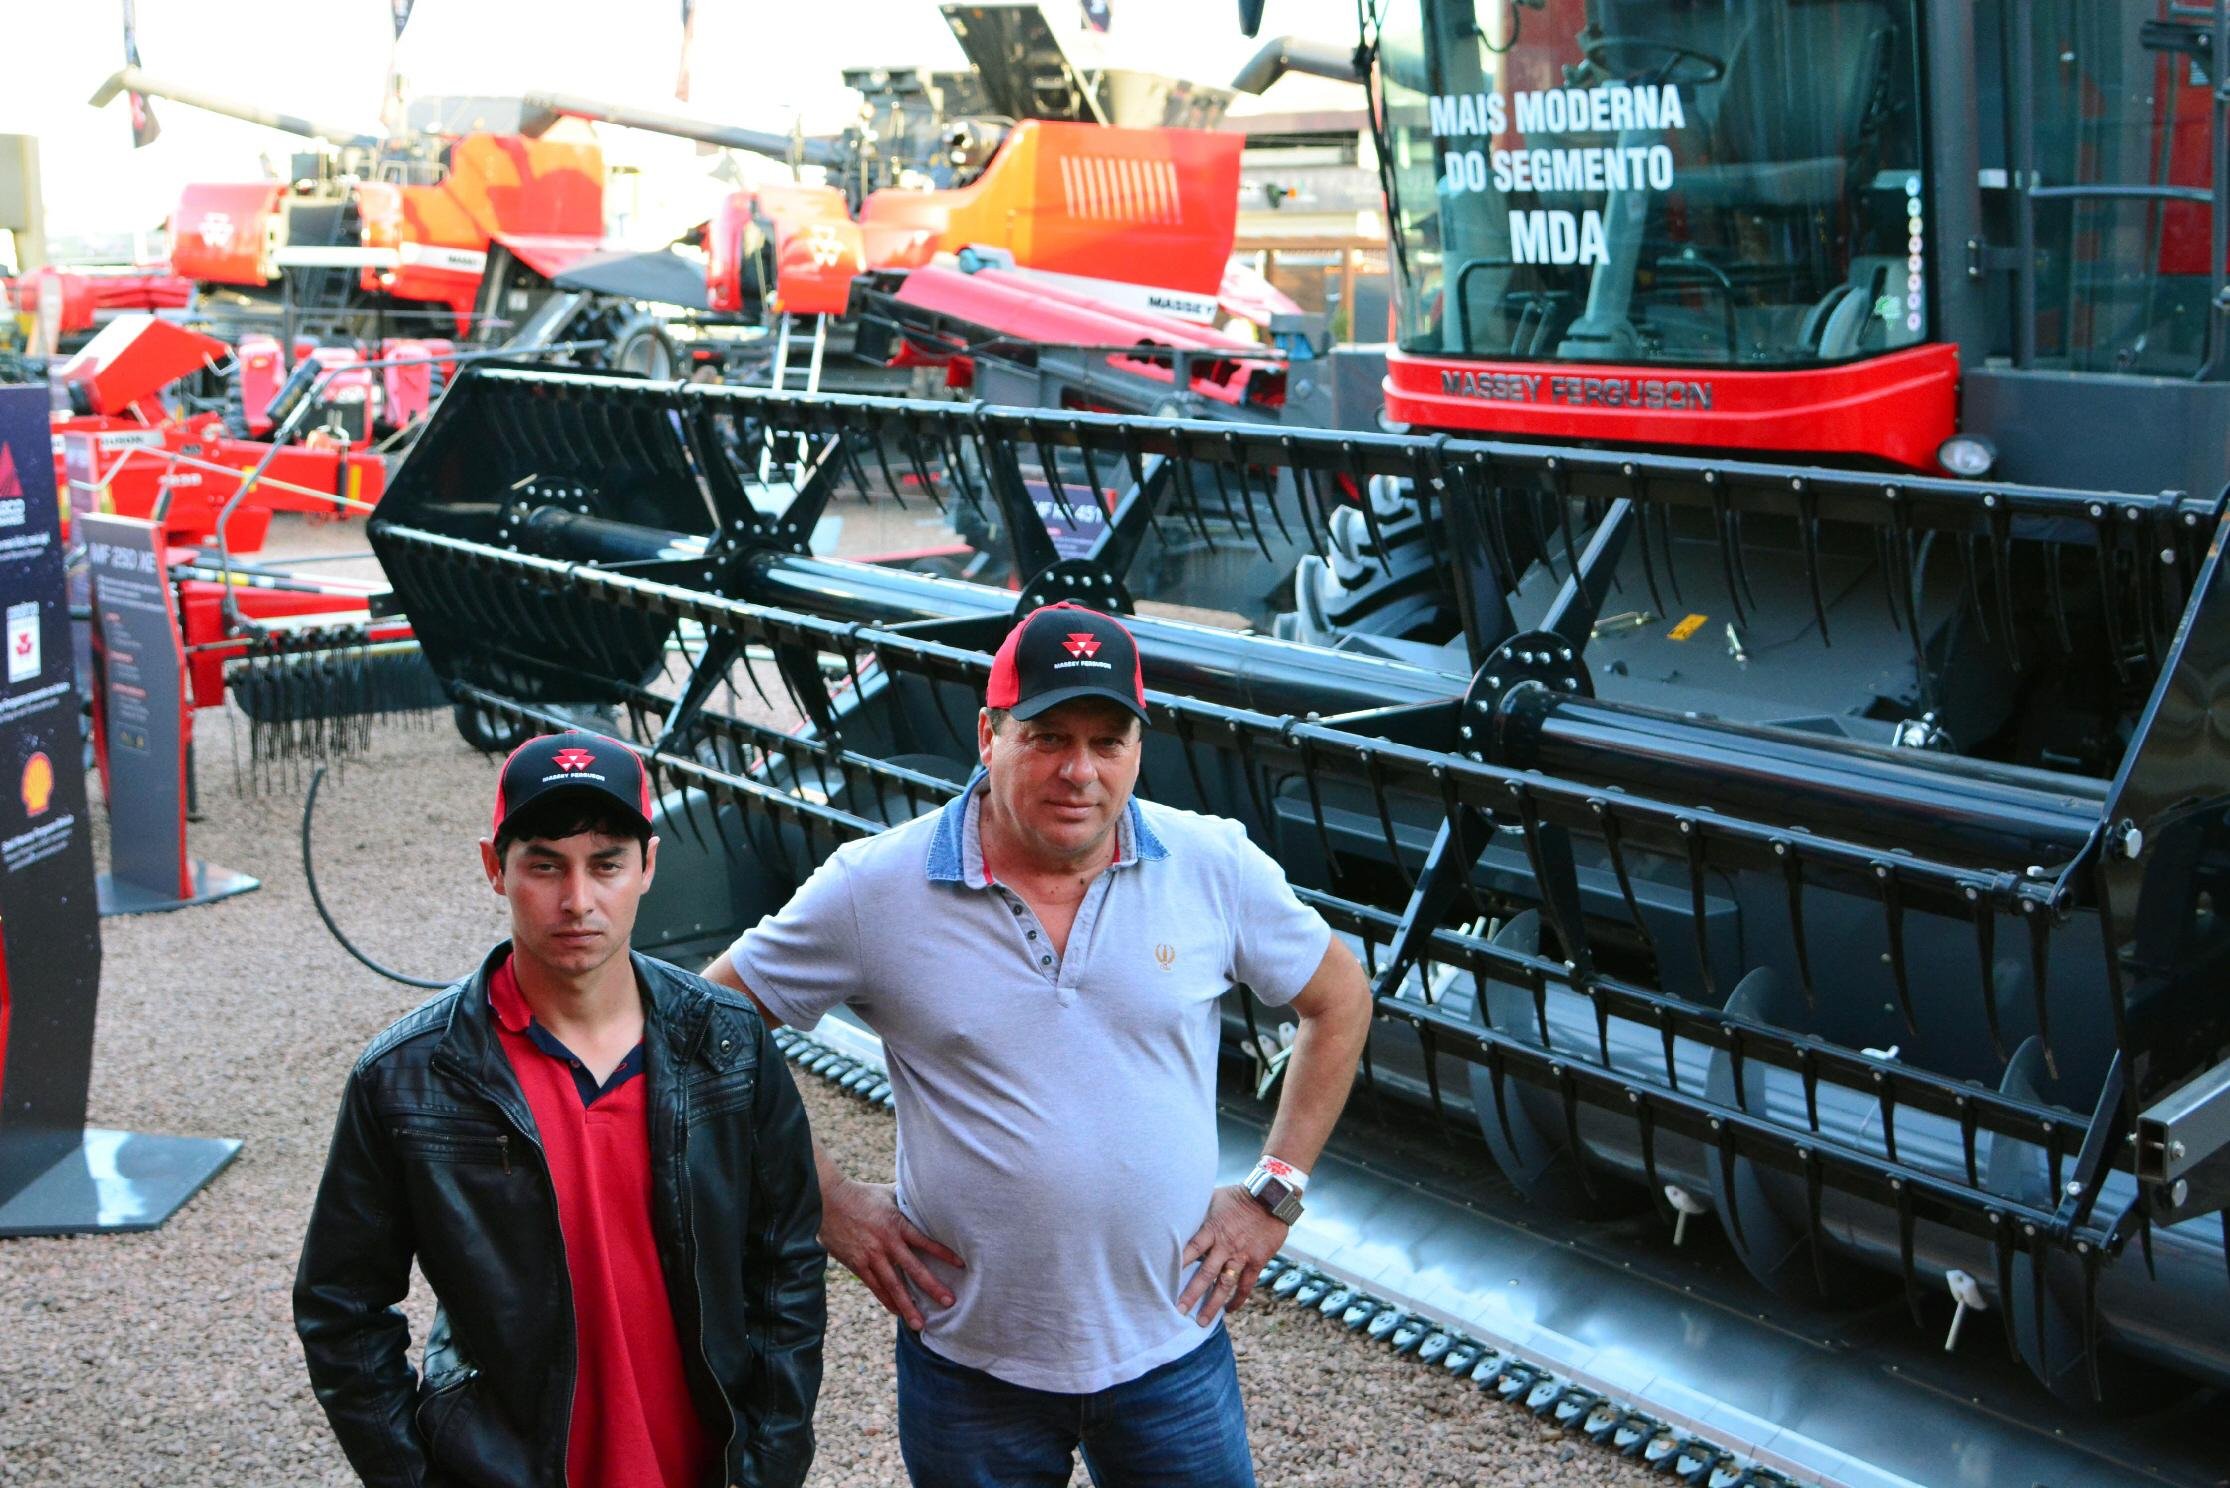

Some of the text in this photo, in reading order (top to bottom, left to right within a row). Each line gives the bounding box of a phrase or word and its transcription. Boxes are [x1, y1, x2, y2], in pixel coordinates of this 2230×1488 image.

[1430, 84, 1685, 136] MAIS MODERNA
[1444, 145, 1674, 192] DO SEGMENTO
[1508, 210, 1610, 265] MDA
[1441, 370, 1713, 410] MASSEY FERGUSON
[542, 773, 569, 782] MASSEY
